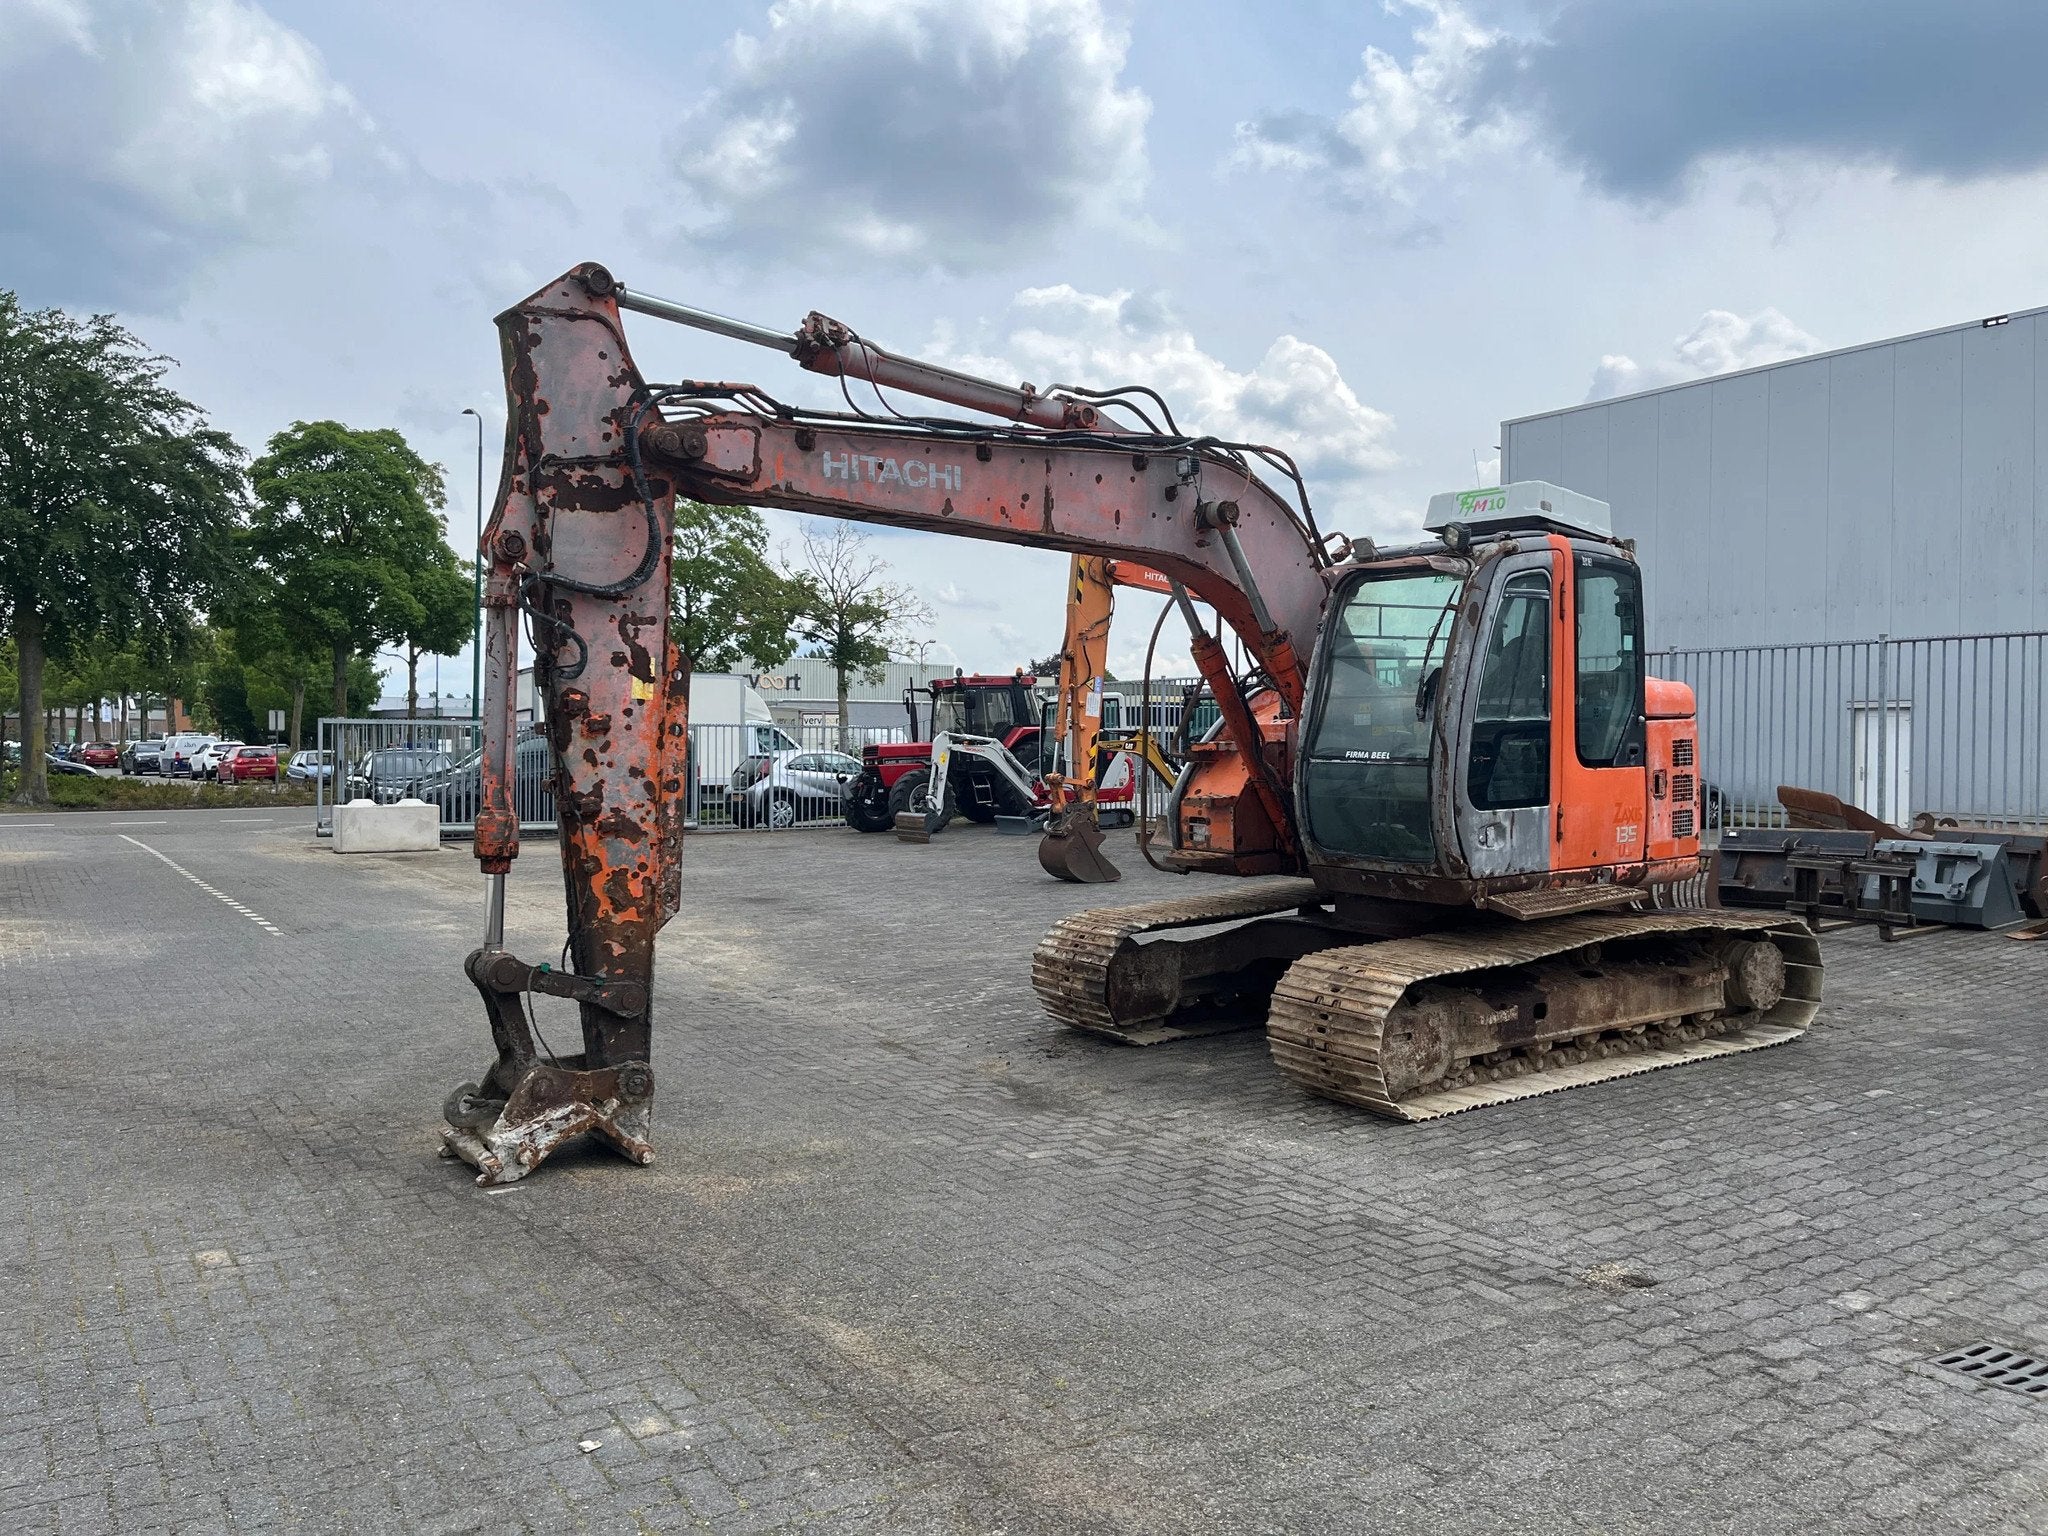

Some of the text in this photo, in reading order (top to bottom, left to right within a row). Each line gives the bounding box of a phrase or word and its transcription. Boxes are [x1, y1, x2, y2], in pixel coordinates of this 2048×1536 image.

[822, 450, 961, 491] HITACHI
[1345, 750, 1369, 759] FIRMA
[1615, 824, 1638, 843] 135
